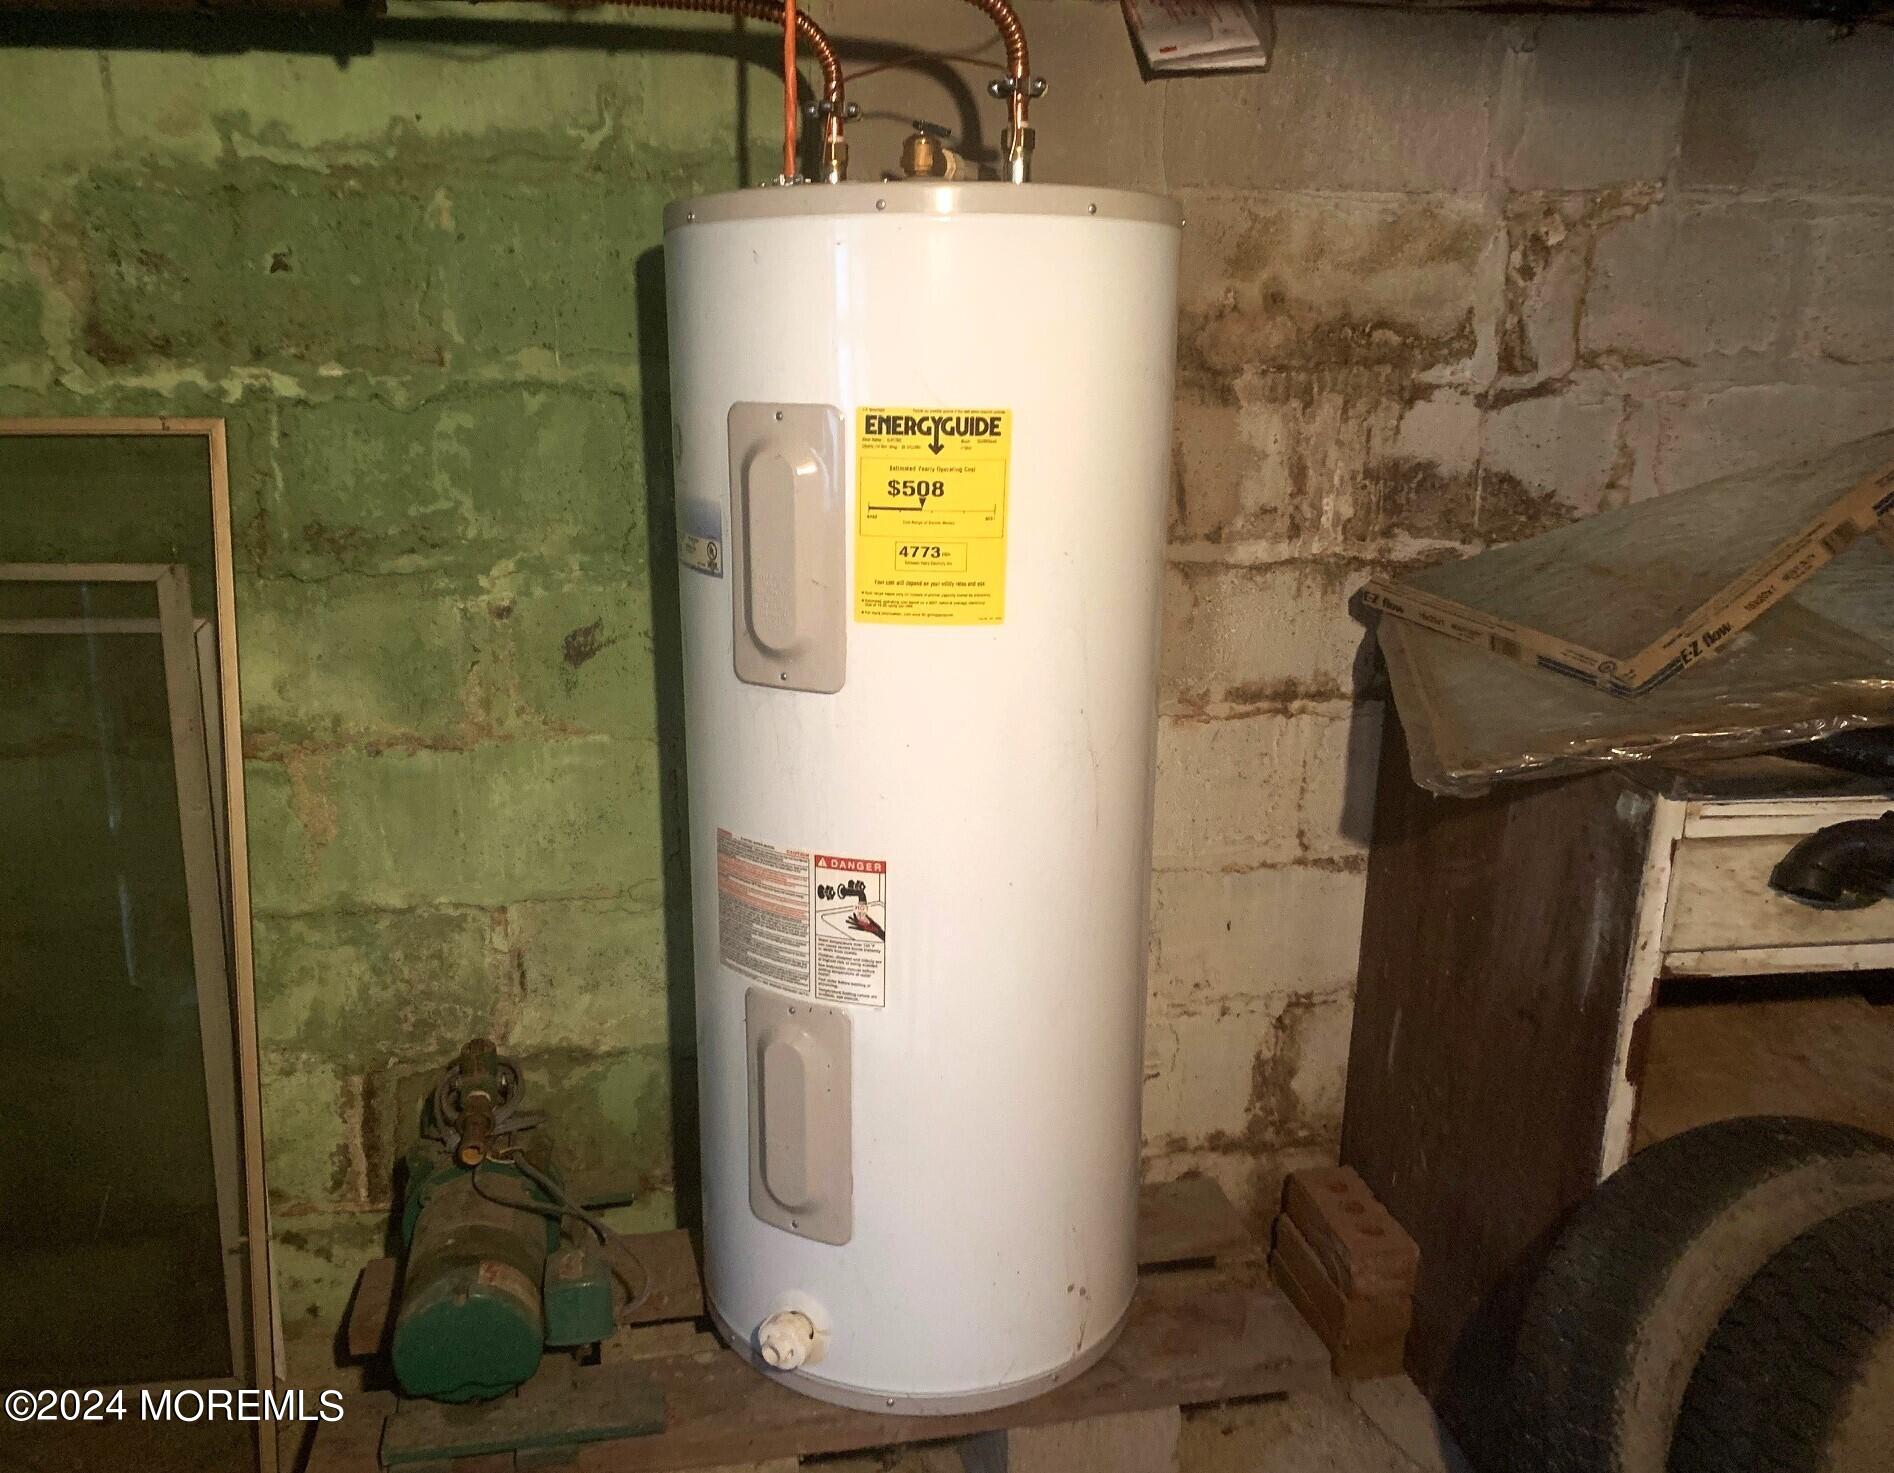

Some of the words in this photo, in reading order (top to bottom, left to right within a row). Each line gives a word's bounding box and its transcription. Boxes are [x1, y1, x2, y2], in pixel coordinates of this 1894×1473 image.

[865, 414, 1002, 437] ENERGYGUIDE
[887, 479, 945, 498] $508
[899, 545, 941, 558] 4773
[1702, 622, 1733, 647] flow
[830, 858, 882, 872] DANGER
